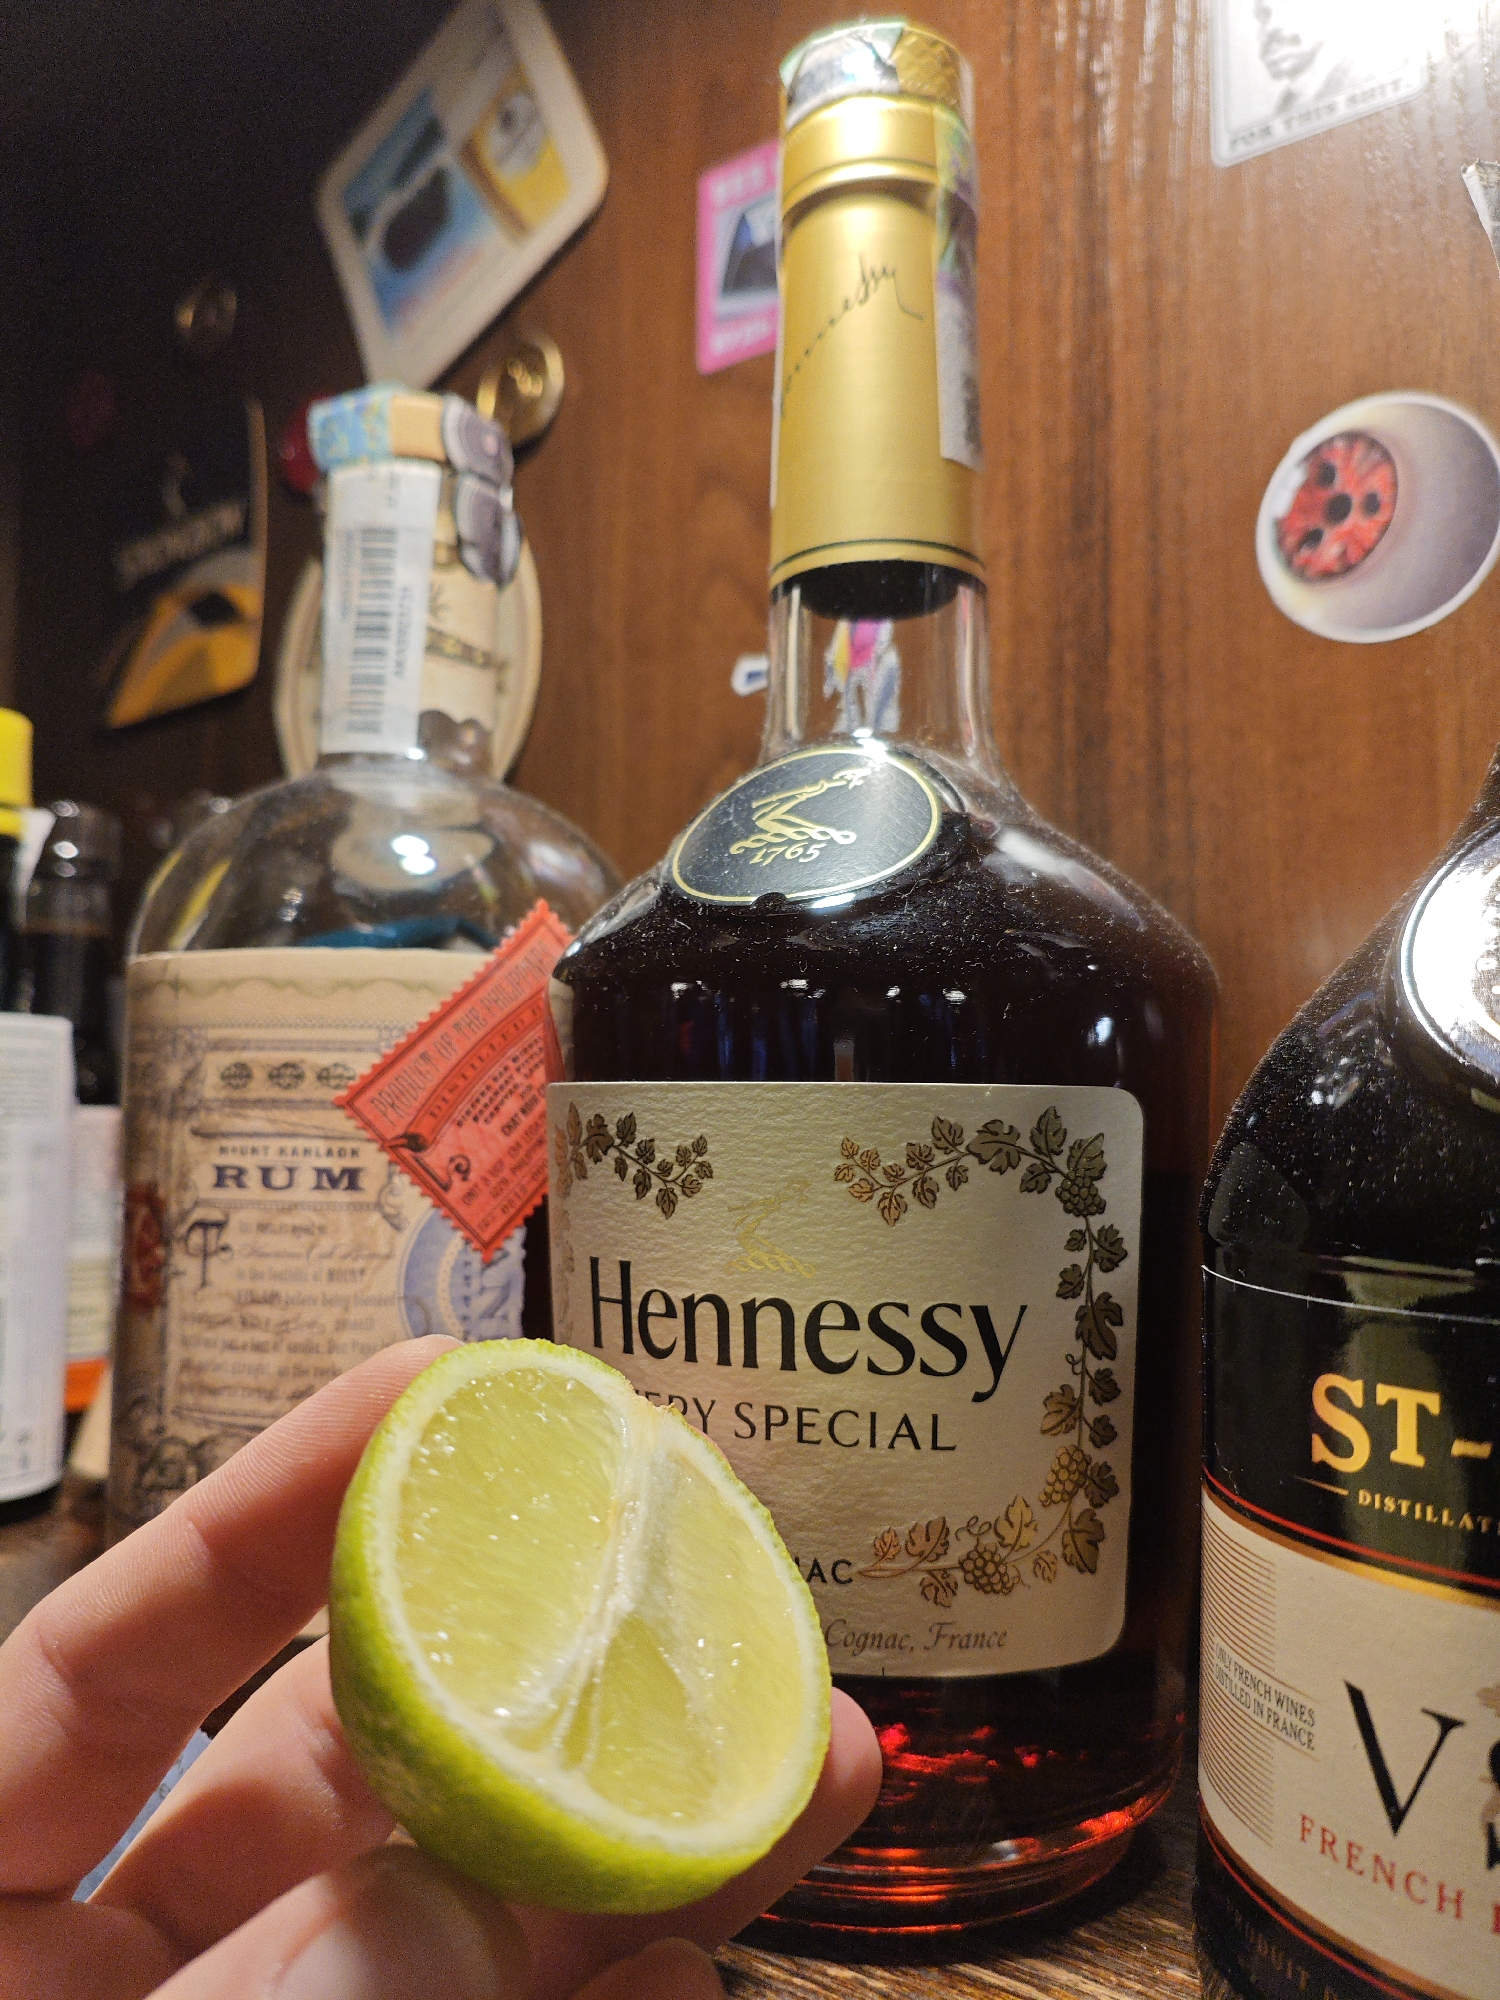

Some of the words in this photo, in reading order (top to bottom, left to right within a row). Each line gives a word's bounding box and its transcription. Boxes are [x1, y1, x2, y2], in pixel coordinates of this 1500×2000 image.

[749, 842, 828, 866] 1765
[369, 1050, 440, 1127] PRODUCT
[433, 1031, 458, 1062] OF
[453, 1005, 488, 1040] THE
[212, 1163, 365, 1192] RUM
[589, 1256, 1028, 1403] Hennessy
[733, 1401, 957, 1451] SPECIAL
[824, 1618, 914, 1656] Cognac,
[922, 1621, 1008, 1651] France
[1215, 1663, 1251, 1710] DISTILLED
[1253, 1698, 1265, 1719] IN
[1266, 1706, 1316, 1751] FRANCE
[1234, 1660, 1272, 1702] FRENCH
[1274, 1689, 1316, 1728] WINES
[1300, 1813, 1466, 1921] FRENCH
